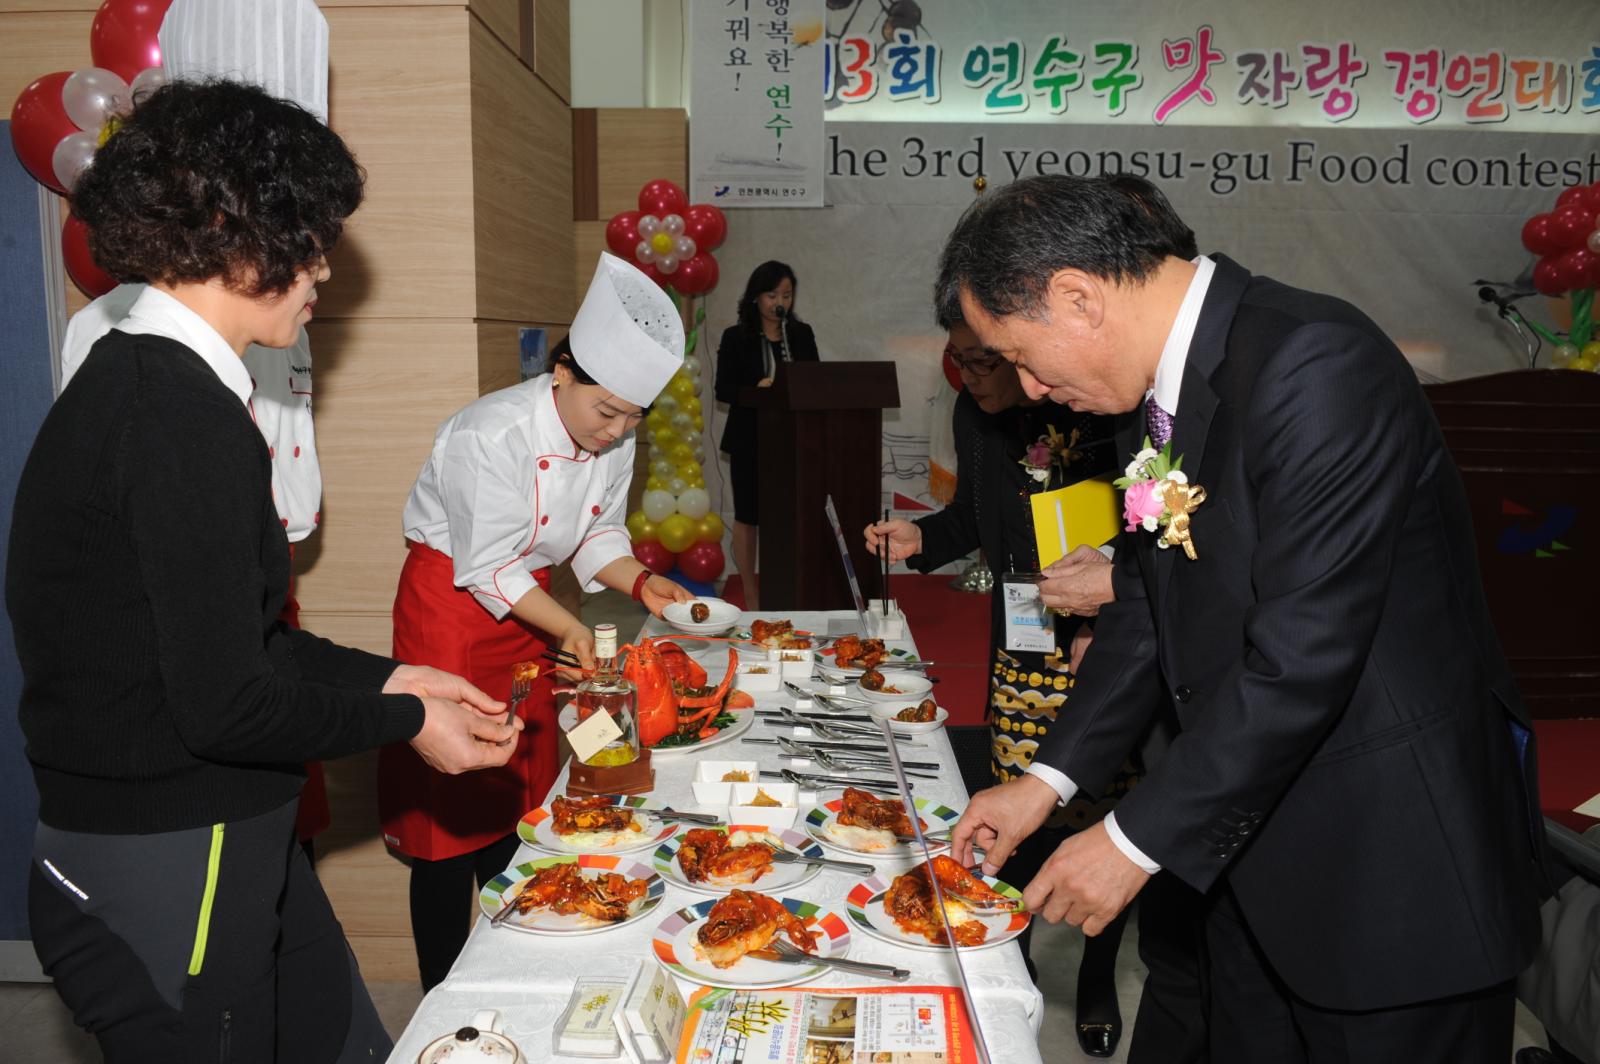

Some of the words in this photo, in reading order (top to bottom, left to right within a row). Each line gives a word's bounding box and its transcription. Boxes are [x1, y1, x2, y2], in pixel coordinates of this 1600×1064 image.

[824, 33, 938, 100] 3회
[962, 36, 1140, 112] 연수구
[1152, 27, 1226, 122] 맛
[1236, 44, 1363, 117] 자랑
[764, 84, 794, 162] 연수!
[828, 135, 888, 177] he
[901, 135, 987, 178] 3rd
[1001, 148, 1273, 195] yeonsu-gu
[1285, 141, 1412, 185] Food
[1425, 152, 1600, 187] contest
